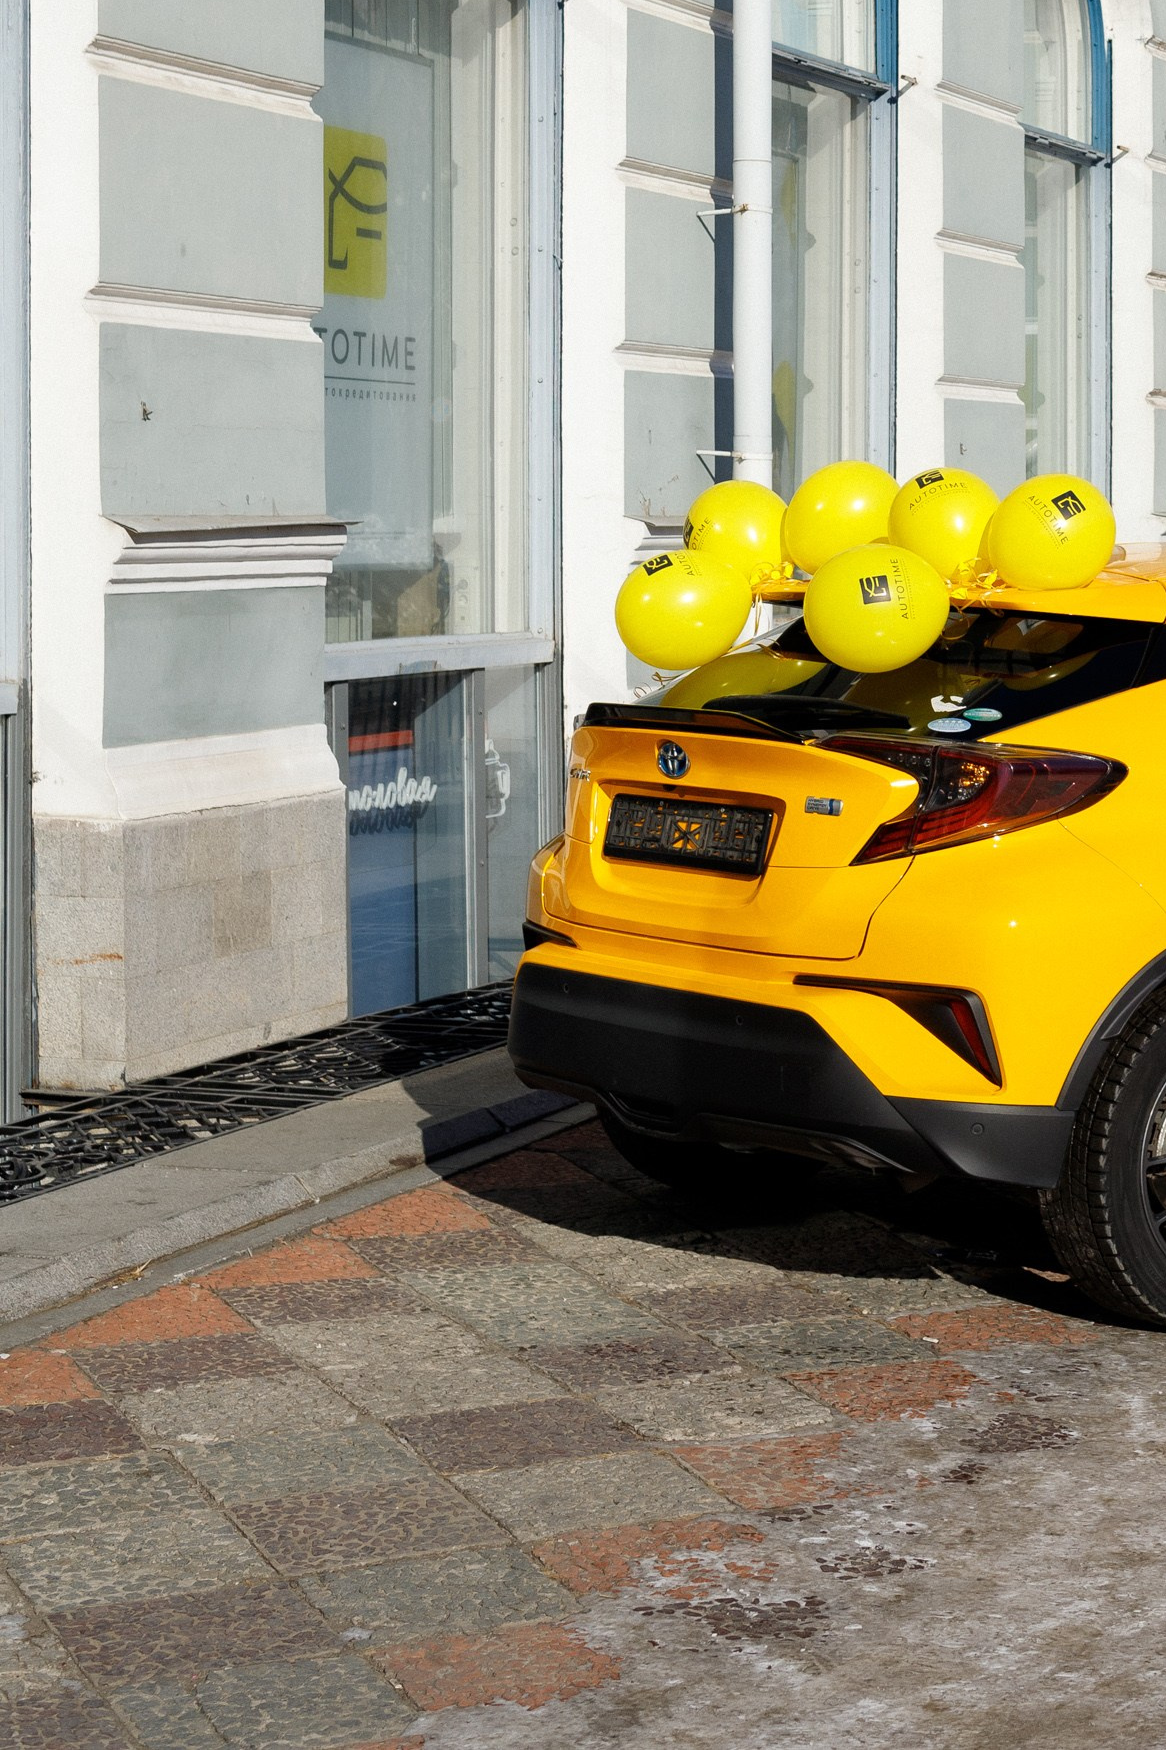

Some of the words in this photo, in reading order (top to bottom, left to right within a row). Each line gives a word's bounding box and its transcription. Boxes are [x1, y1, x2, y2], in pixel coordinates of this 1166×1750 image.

[909, 482, 968, 510] AUTOTIME
[1028, 495, 1069, 545] AUTOTIME
[674, 553, 695, 576] AUTO
[889, 558, 909, 620] AUTOTIME
